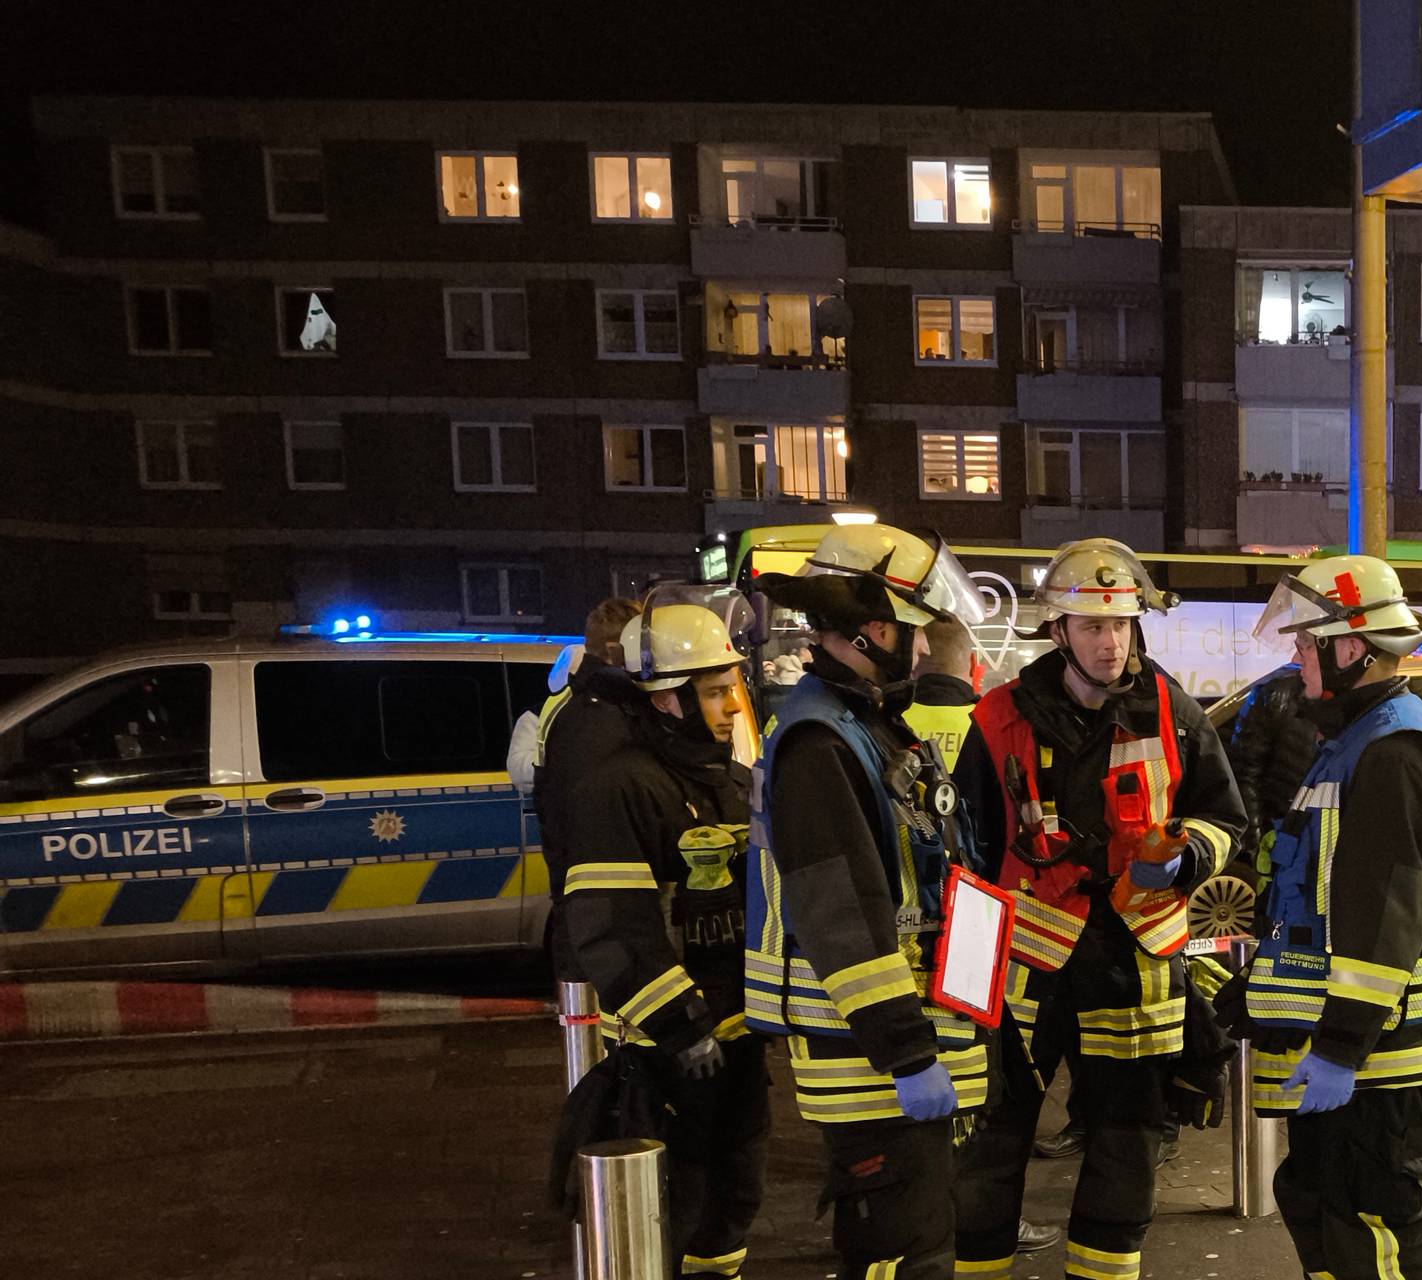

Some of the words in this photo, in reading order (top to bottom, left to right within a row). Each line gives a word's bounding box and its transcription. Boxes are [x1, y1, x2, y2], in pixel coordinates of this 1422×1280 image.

[1095, 566, 1117, 588] C
[1150, 616, 1191, 656] uf
[41, 827, 193, 862] POLIZEI
[1279, 958, 1325, 971] DORTMUND
[1280, 951, 1326, 963] FEUERWEHR
